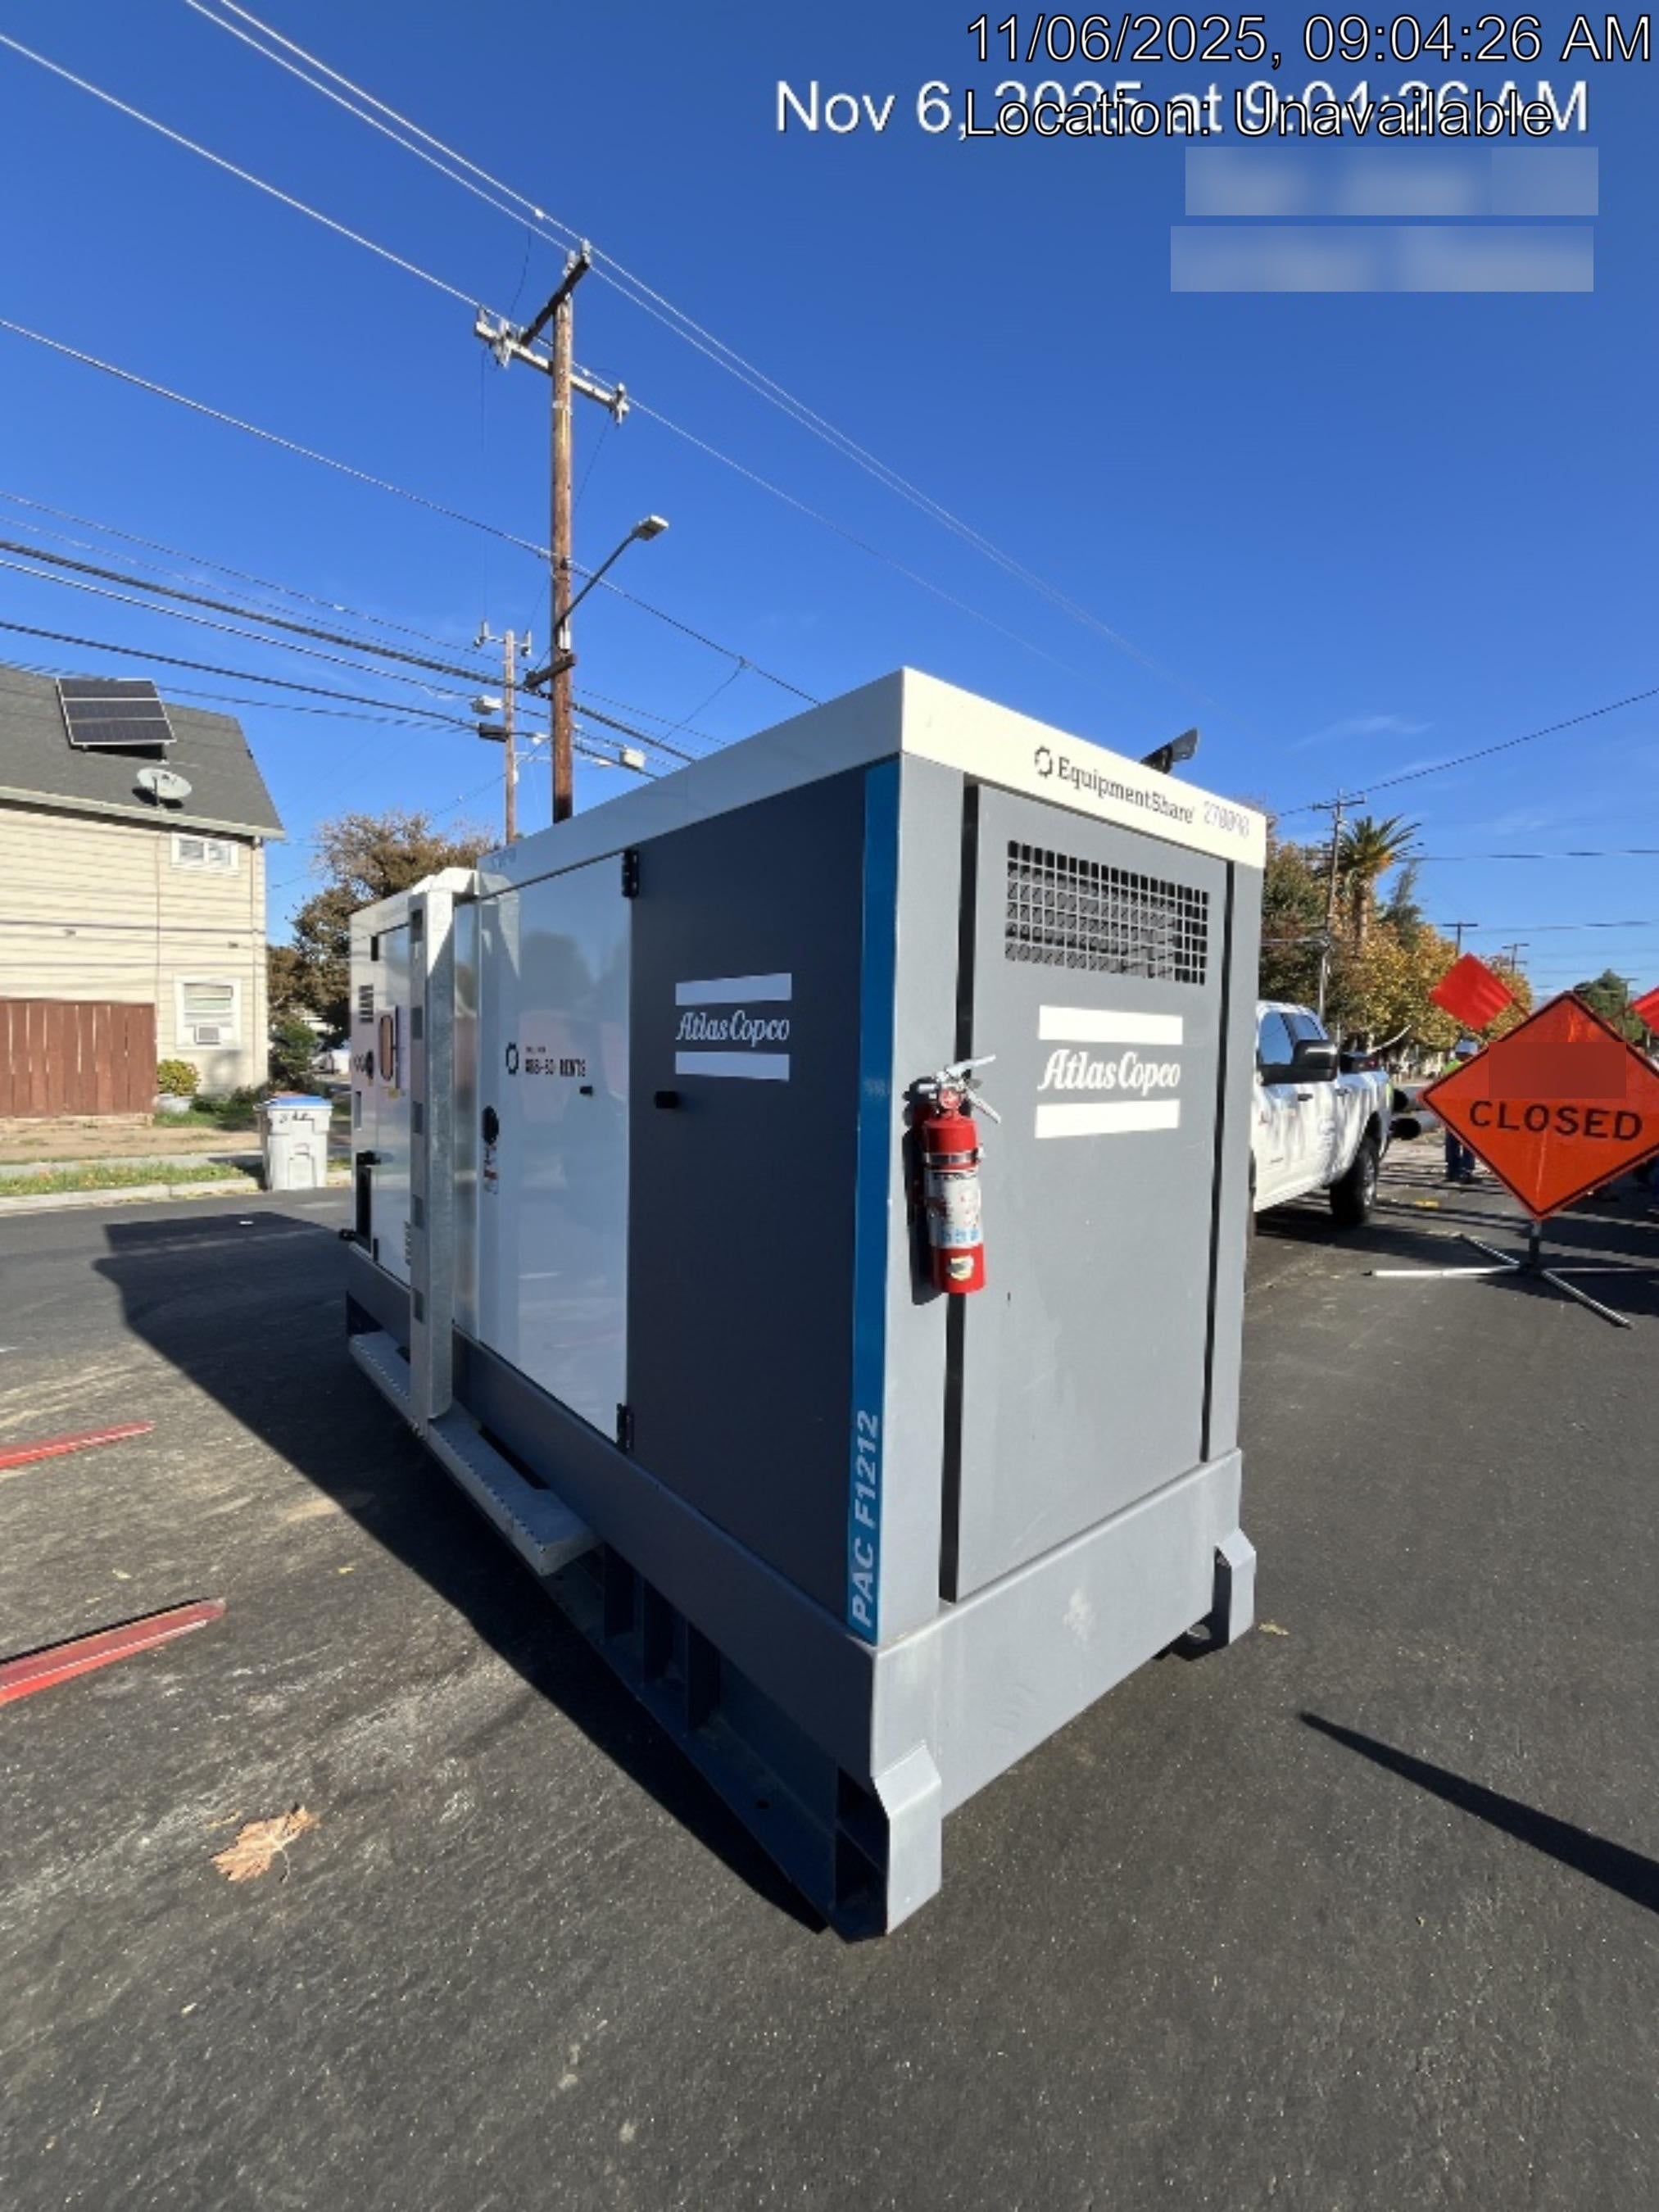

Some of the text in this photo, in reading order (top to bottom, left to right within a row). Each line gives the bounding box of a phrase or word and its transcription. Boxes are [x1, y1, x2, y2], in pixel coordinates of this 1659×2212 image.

[1057, 756, 1194, 824] EquipmentShare
[1469, 1100, 1643, 1140] CLOSED
[851, 1410, 879, 1628] PAC F1212
